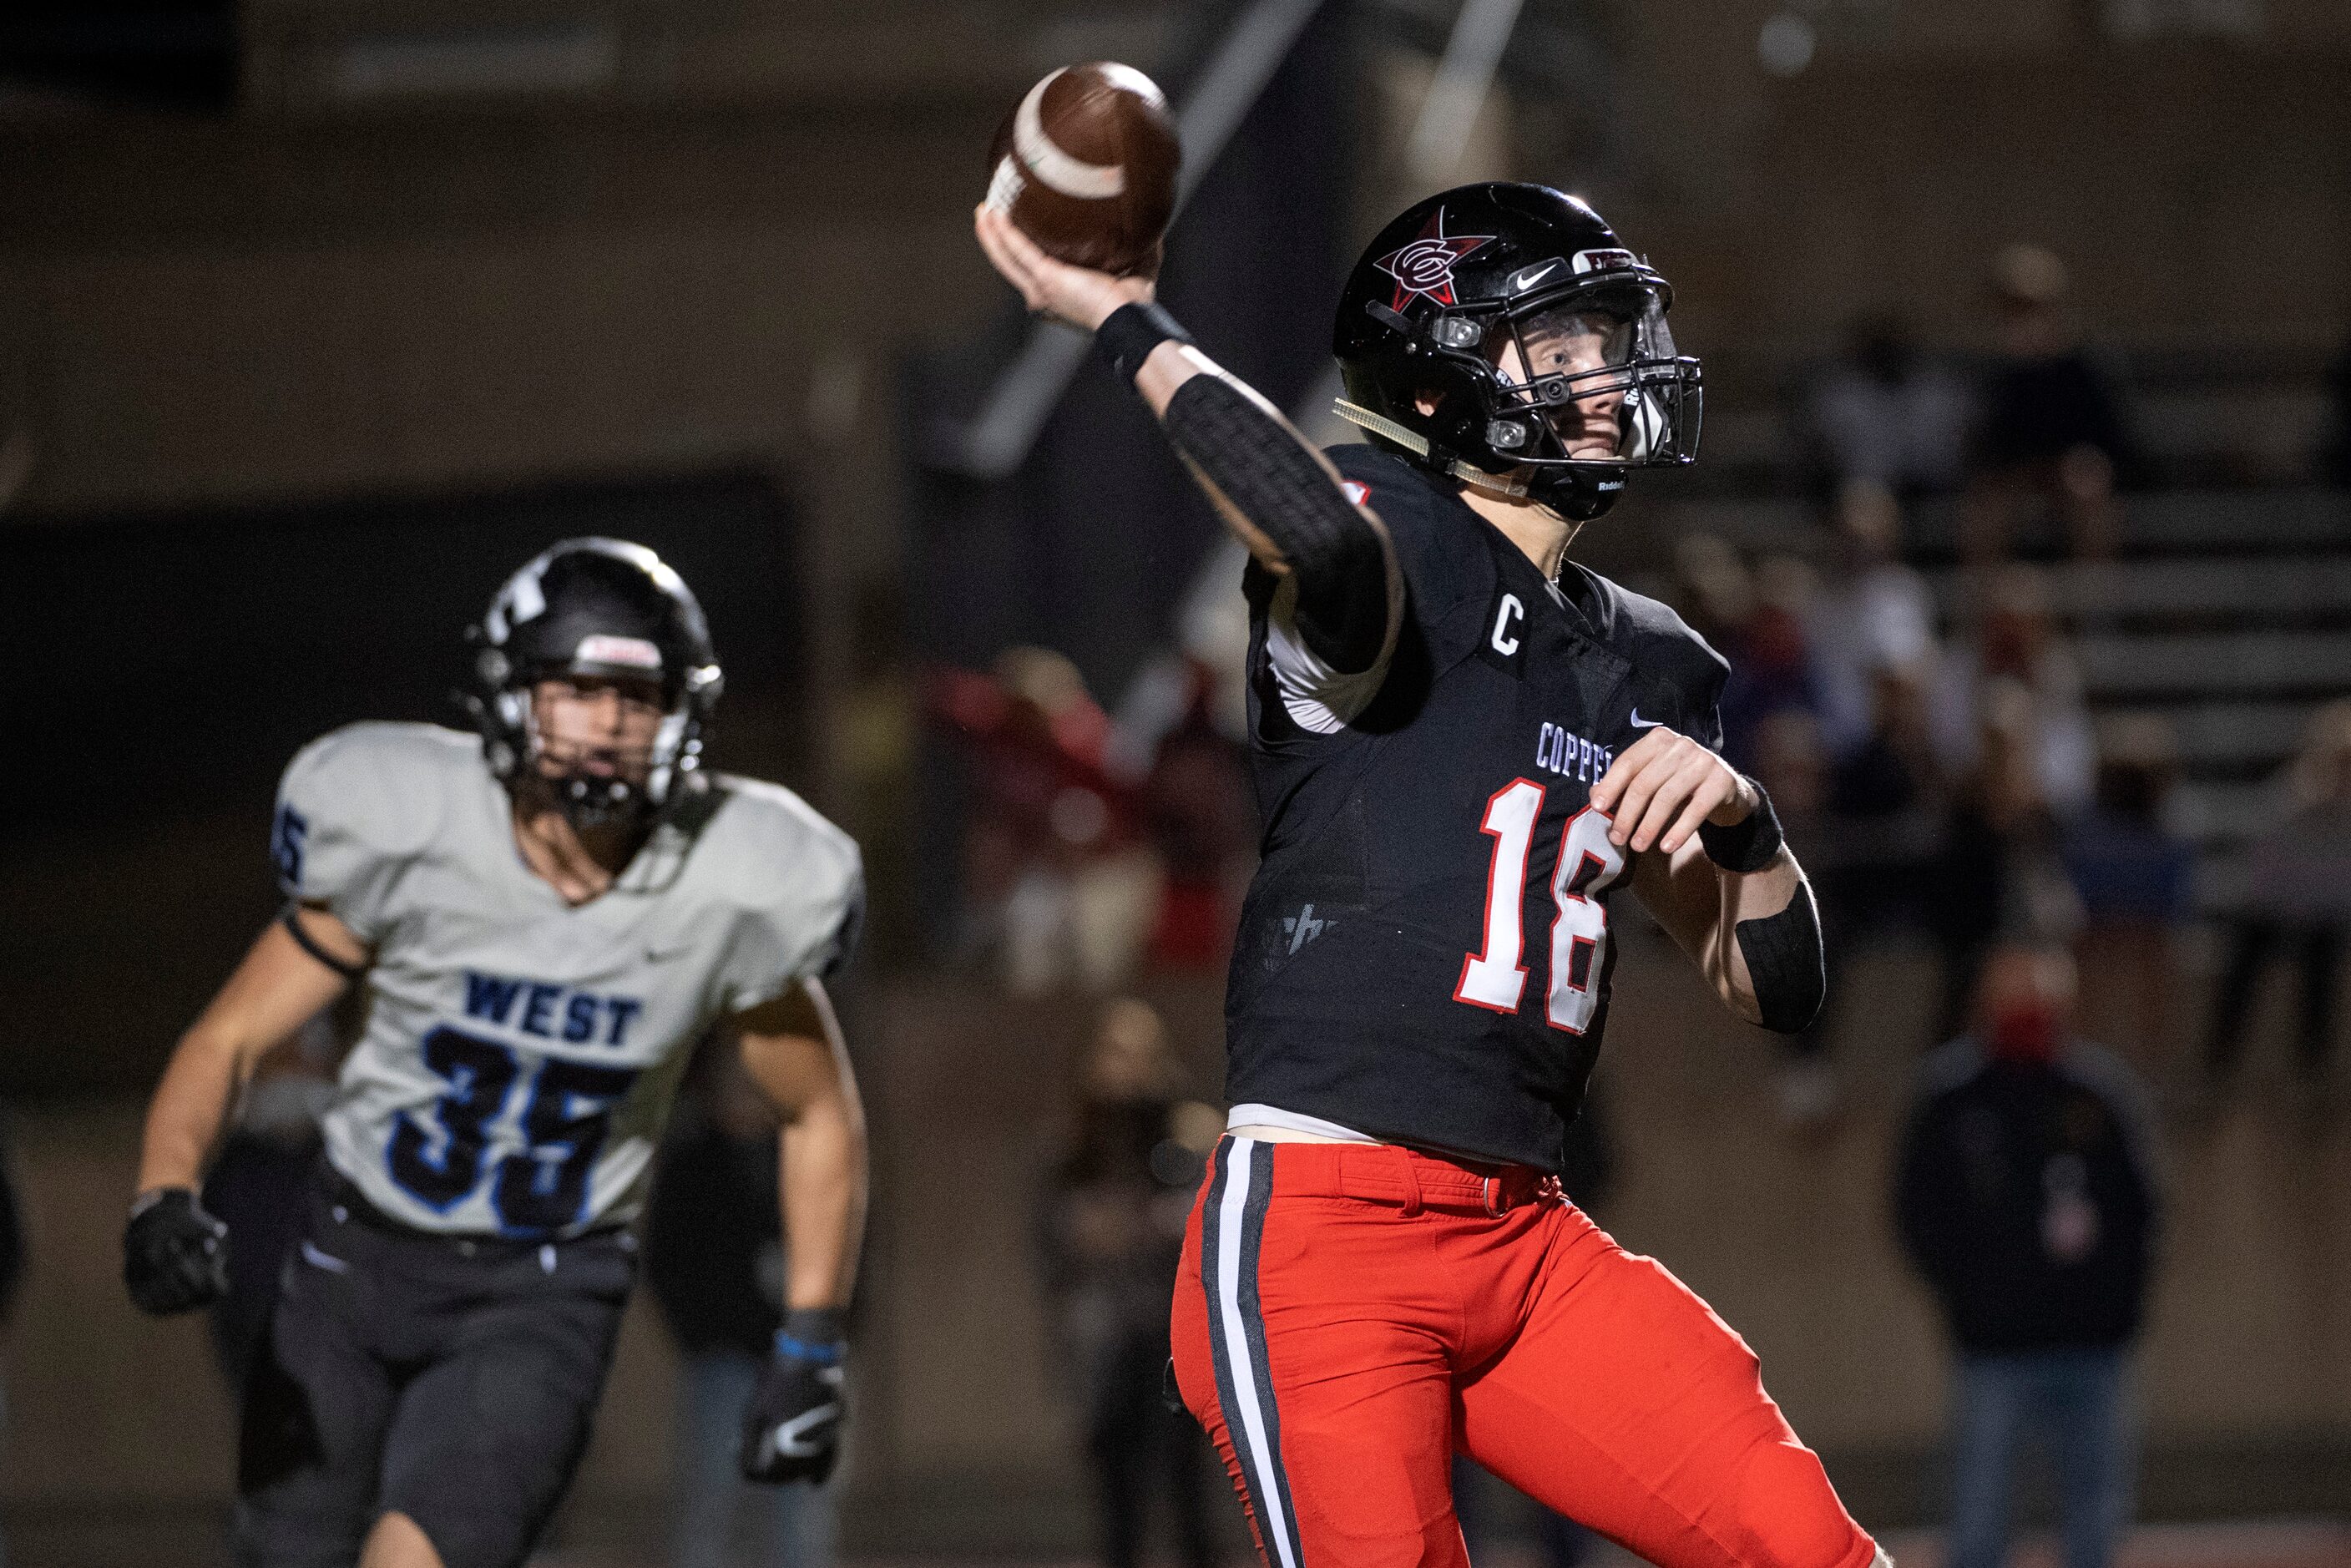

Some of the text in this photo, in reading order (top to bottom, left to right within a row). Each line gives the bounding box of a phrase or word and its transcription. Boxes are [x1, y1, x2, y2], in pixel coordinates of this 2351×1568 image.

[1491, 593, 1524, 655] C
[1453, 776, 1627, 1036] 18
[464, 969, 642, 1048] WEST
[384, 1024, 638, 1237] 35
